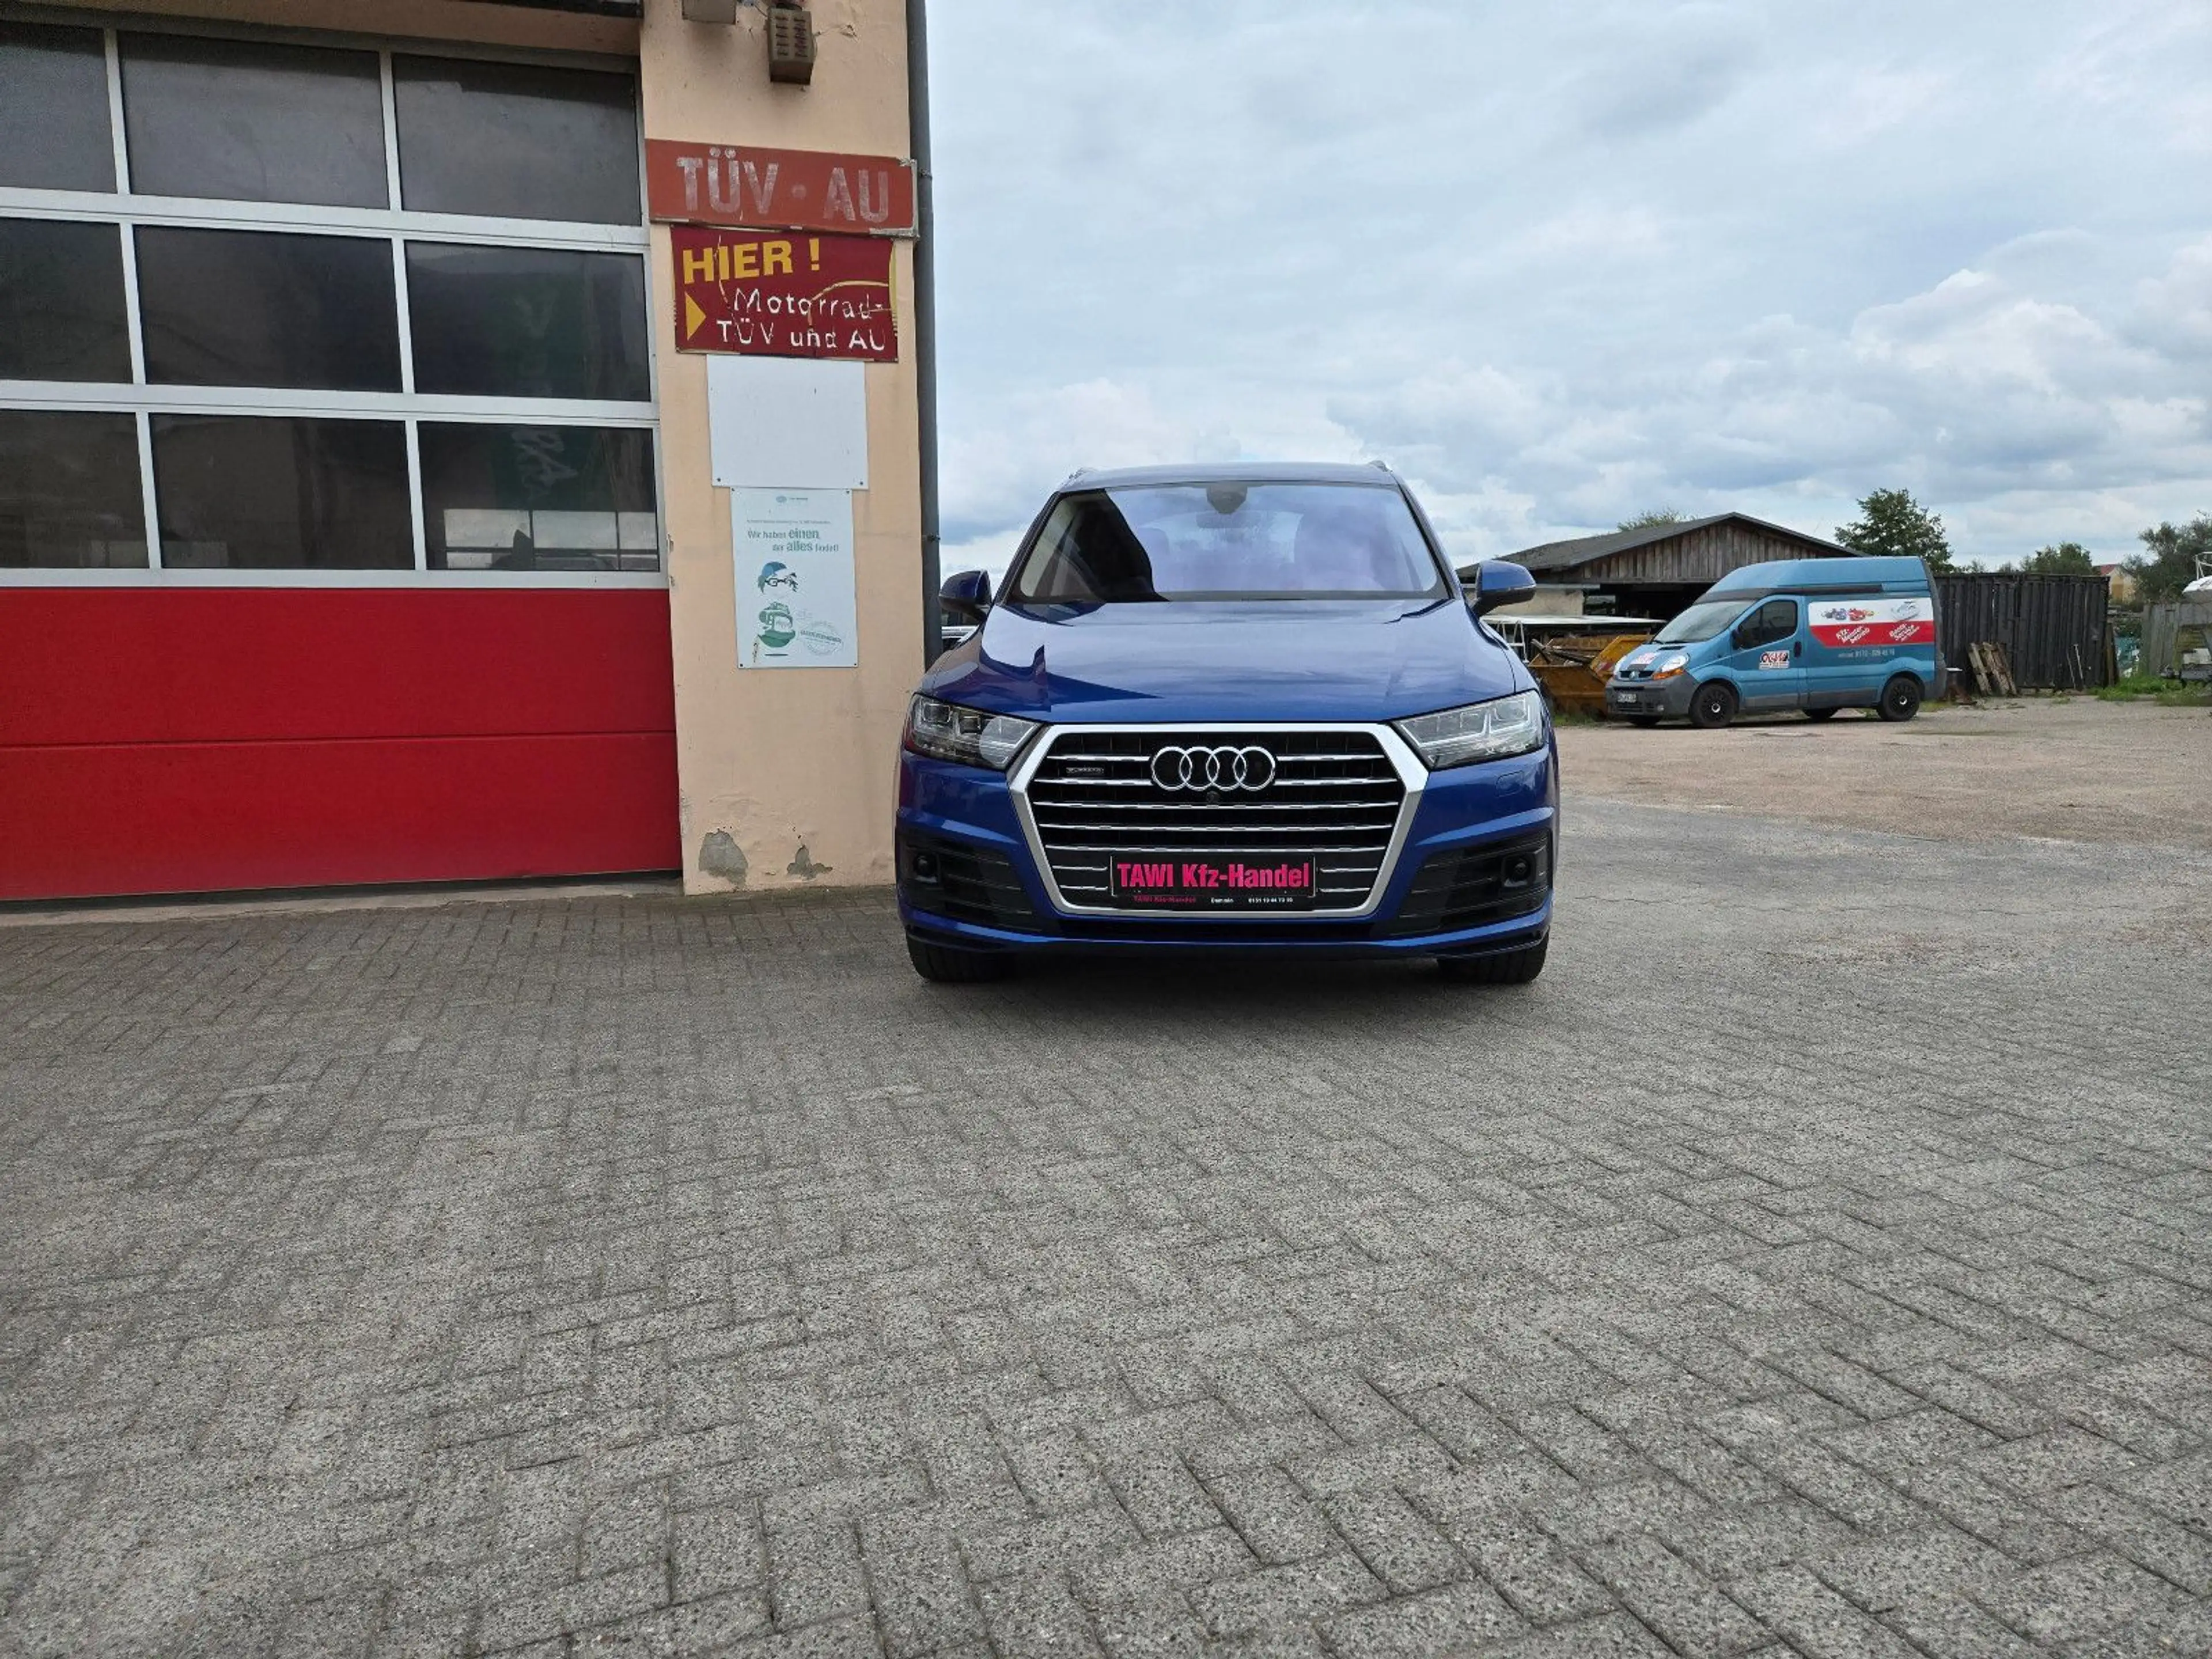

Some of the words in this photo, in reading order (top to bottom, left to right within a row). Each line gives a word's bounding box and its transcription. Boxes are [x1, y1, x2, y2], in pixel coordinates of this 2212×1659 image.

[677, 147, 779, 214] TÜV
[823, 167, 889, 222] AU
[683, 240, 793, 284] HIER
[717, 319, 775, 344] TÜV
[790, 327, 836, 348] und
[849, 329, 885, 351] AU
[786, 541, 813, 551] alles
[788, 528, 819, 539] einen
[1117, 863, 1174, 888] TAWI
[1182, 862, 1309, 888] Kfz-Handel
